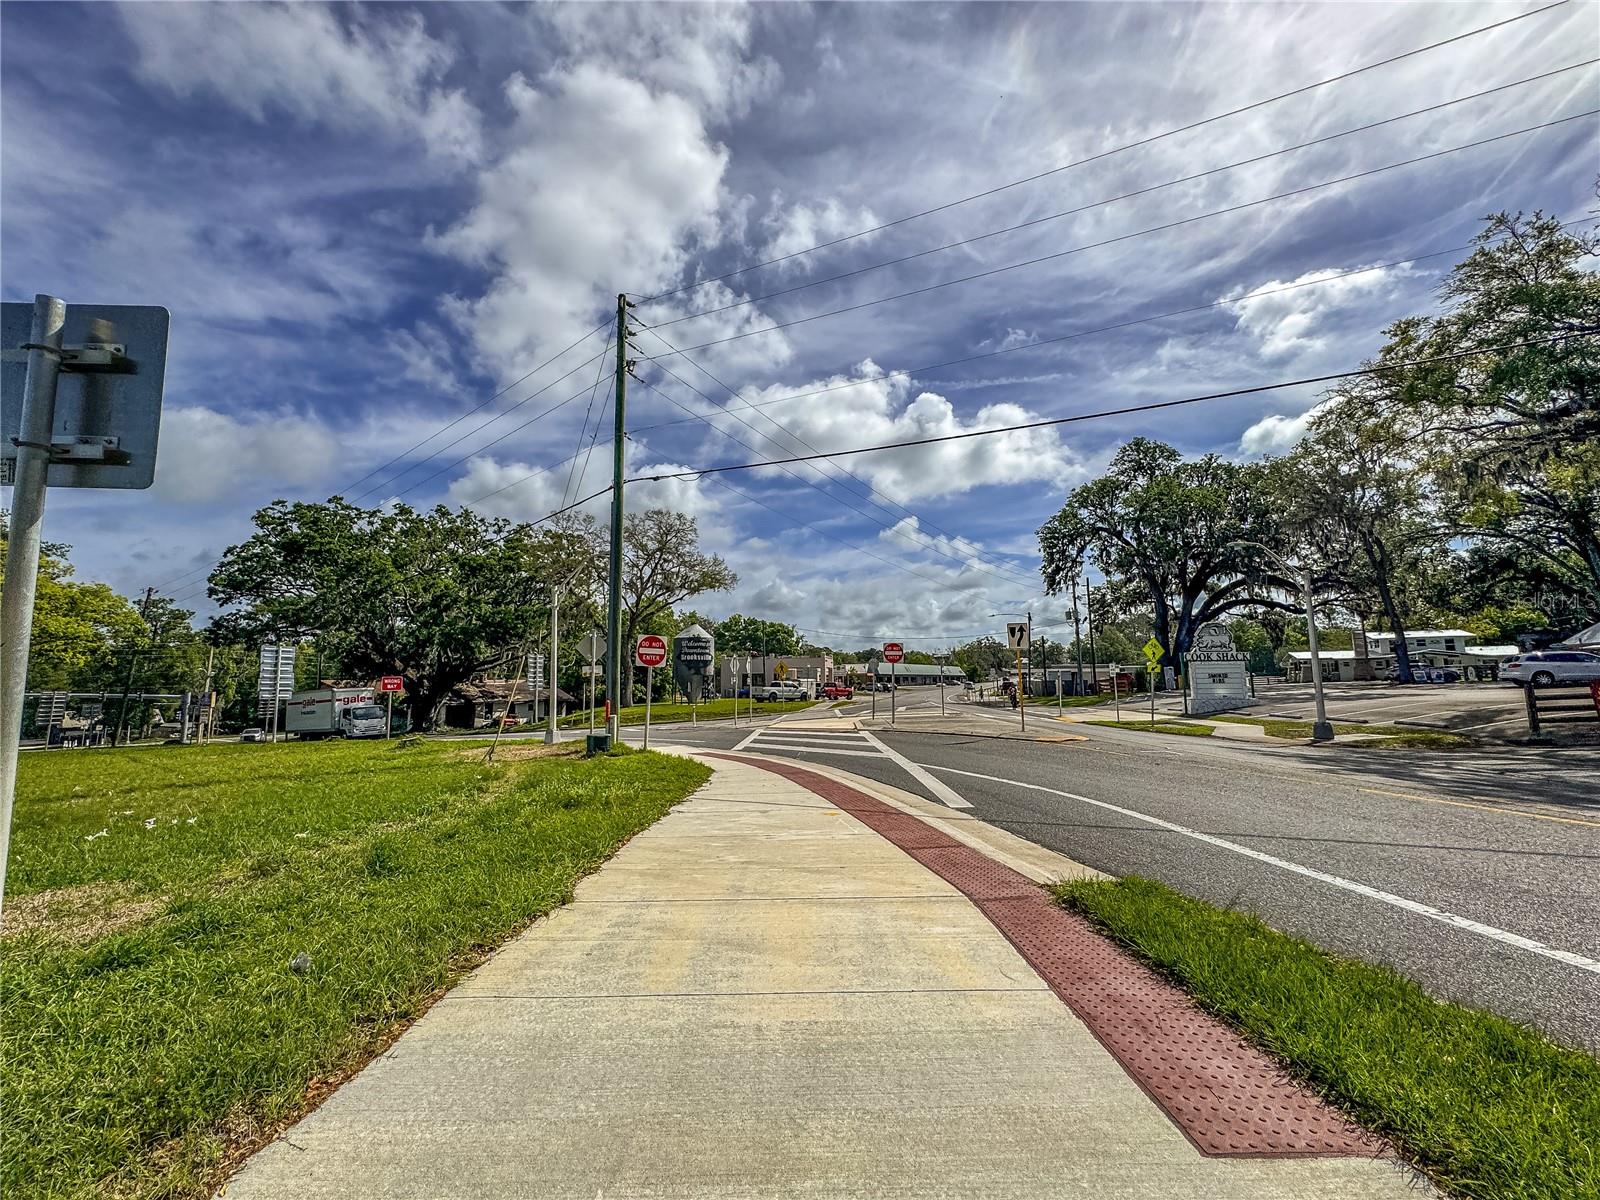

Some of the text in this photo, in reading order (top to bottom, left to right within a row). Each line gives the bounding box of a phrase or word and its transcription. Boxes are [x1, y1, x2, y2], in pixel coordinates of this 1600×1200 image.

[1184, 652, 1249, 661] COOK SHACK
[342, 694, 367, 705] gale
